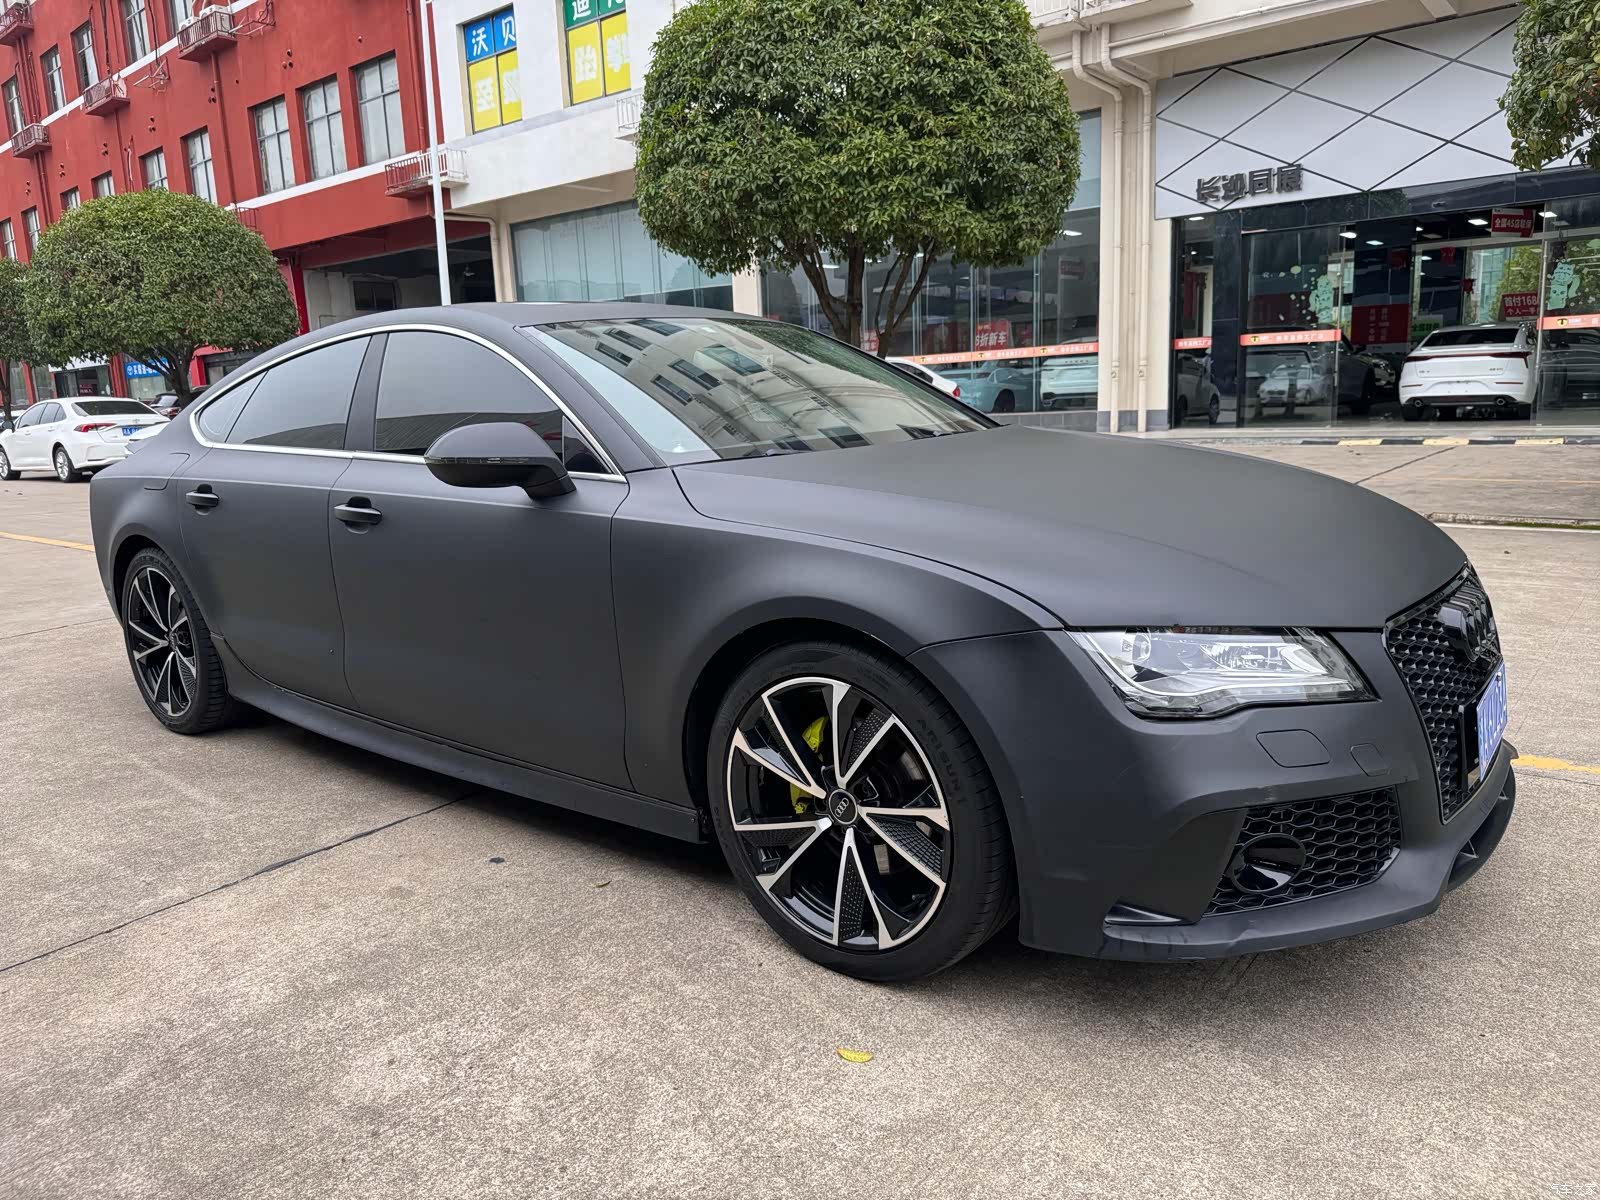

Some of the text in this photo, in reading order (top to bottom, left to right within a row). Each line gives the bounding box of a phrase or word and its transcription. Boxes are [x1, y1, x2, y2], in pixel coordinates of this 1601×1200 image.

[571, 0, 624, 21] 迪
[472, 16, 516, 56] 沃贝
[1504, 295, 1540, 307] 首付168
[1506, 307, 1540, 316] 个人一手
